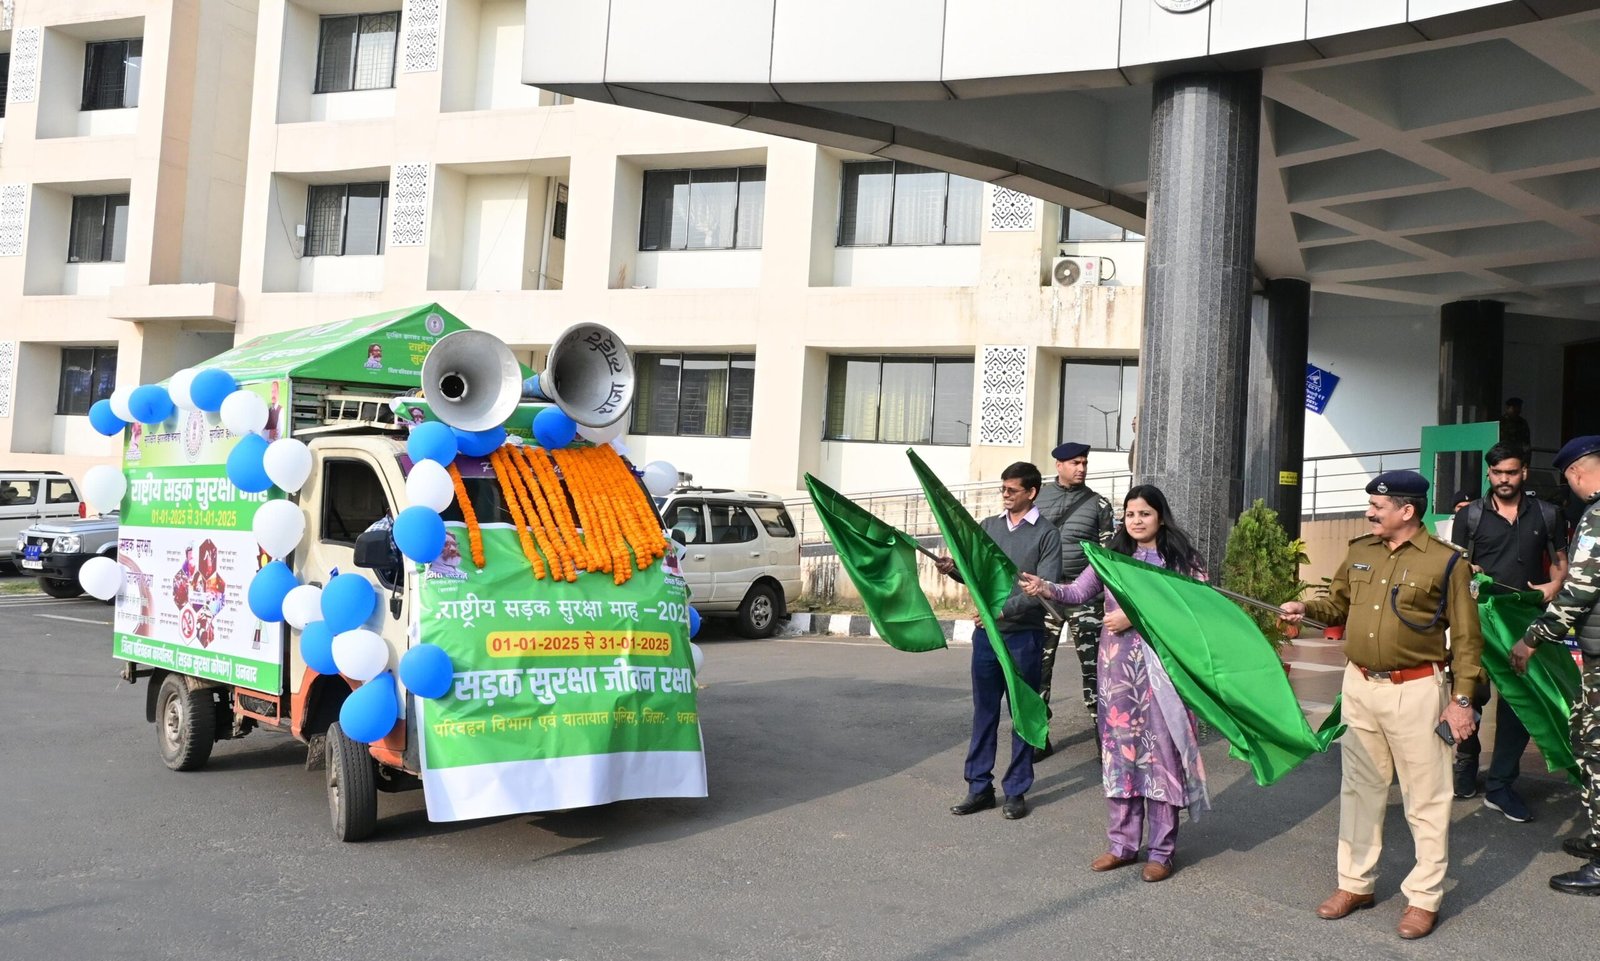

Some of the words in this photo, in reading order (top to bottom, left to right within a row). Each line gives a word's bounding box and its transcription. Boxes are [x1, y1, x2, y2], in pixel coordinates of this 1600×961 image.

[592, 381, 626, 414] राजा
[130, 472, 162, 506] राष्ट्रीय
[163, 478, 194, 508] सड़क
[195, 477, 235, 511] सुरक्षा
[151, 509, 185, 525] 01-01-2025
[195, 510, 236, 526] 31-01-2025
[437, 592, 496, 628] राष्ट्रीय
[502, 600, 551, 621] सड़क
[556, 600, 602, 624] सुरक्षा
[608, 601, 639, 622] माह
[492, 637, 580, 652] 01-01-2025
[583, 631, 595, 649] से
[599, 637, 669, 651] 31-01-2025
[453, 669, 523, 706] सड़क
[526, 667, 597, 704] सुरक्षा
[600, 658, 656, 692] जीवन
[658, 667, 691, 693] रक्षा
[433, 718, 486, 737] परिवहन
[491, 714, 532, 732] विभाग
[538, 711, 557, 733] एवं
[562, 711, 609, 727] यातायात
